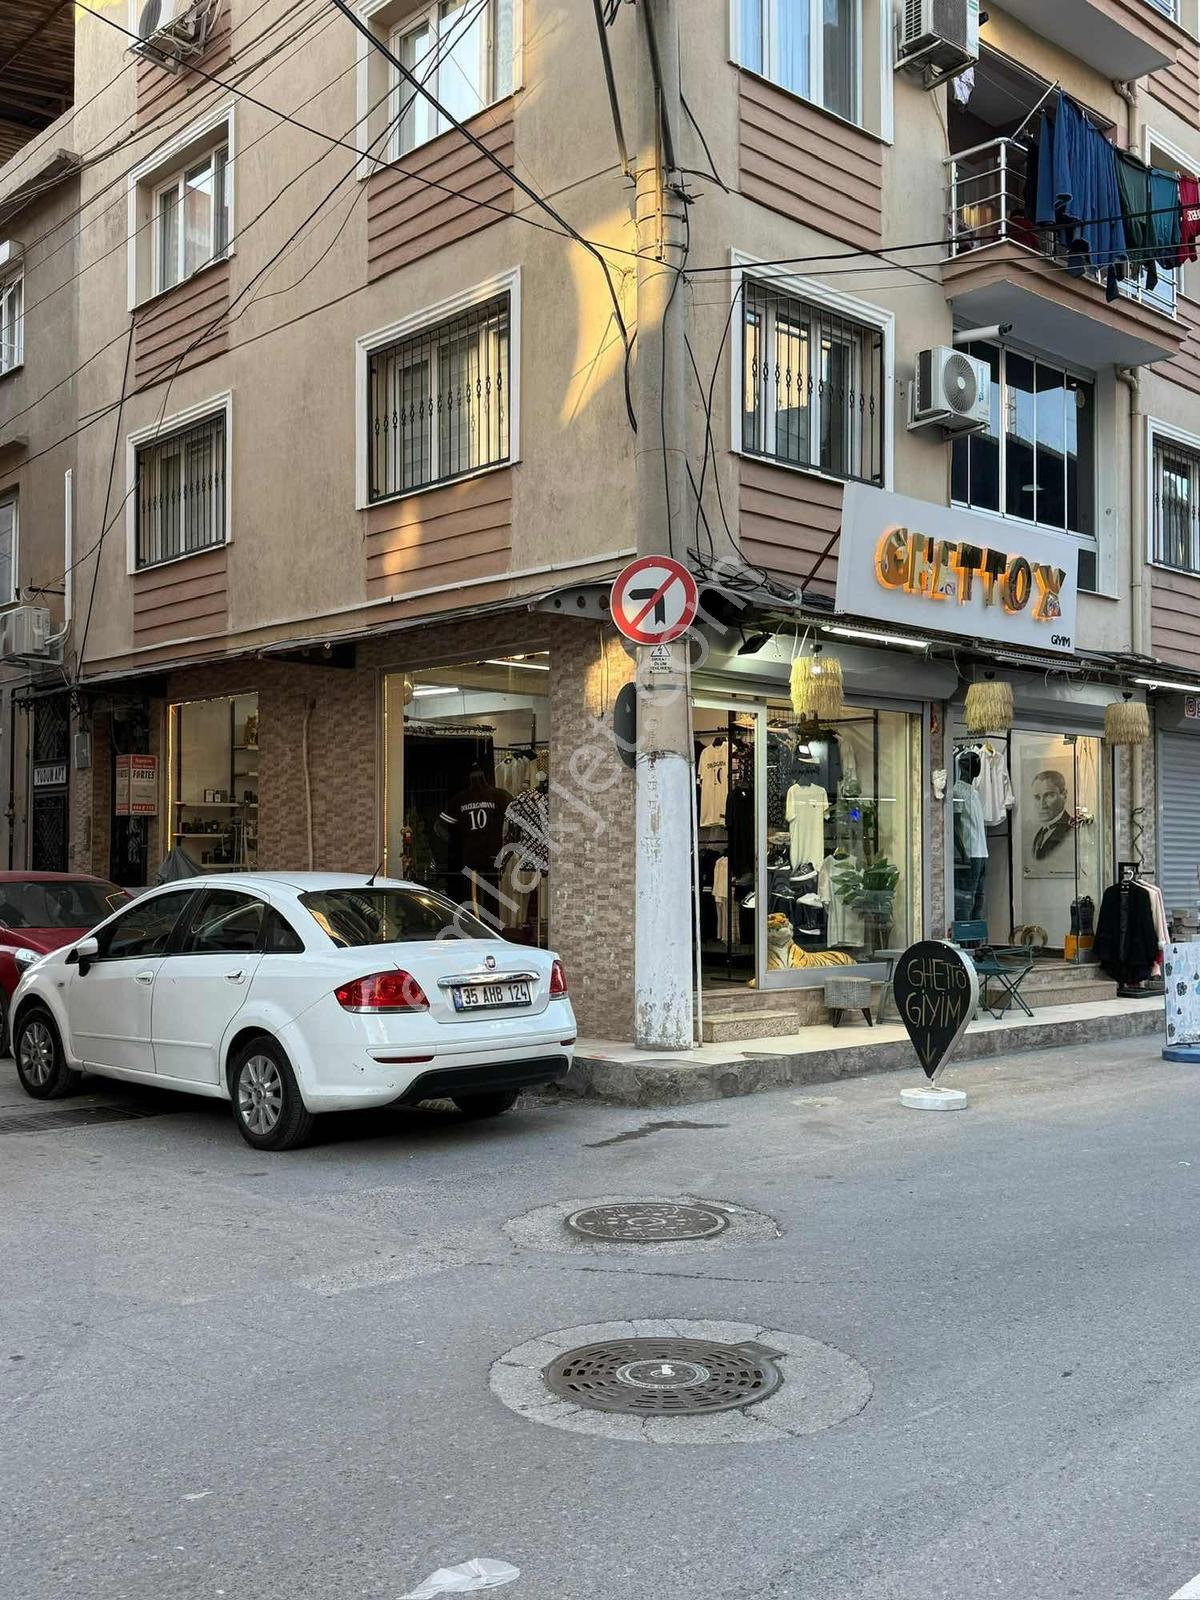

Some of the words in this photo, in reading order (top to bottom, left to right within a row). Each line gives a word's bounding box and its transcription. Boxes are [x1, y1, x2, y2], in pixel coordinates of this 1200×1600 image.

[468, 808, 488, 831] 10
[463, 988, 479, 1005] 35
[483, 986, 504, 1004] AHB
[507, 983, 528, 1002] 124
